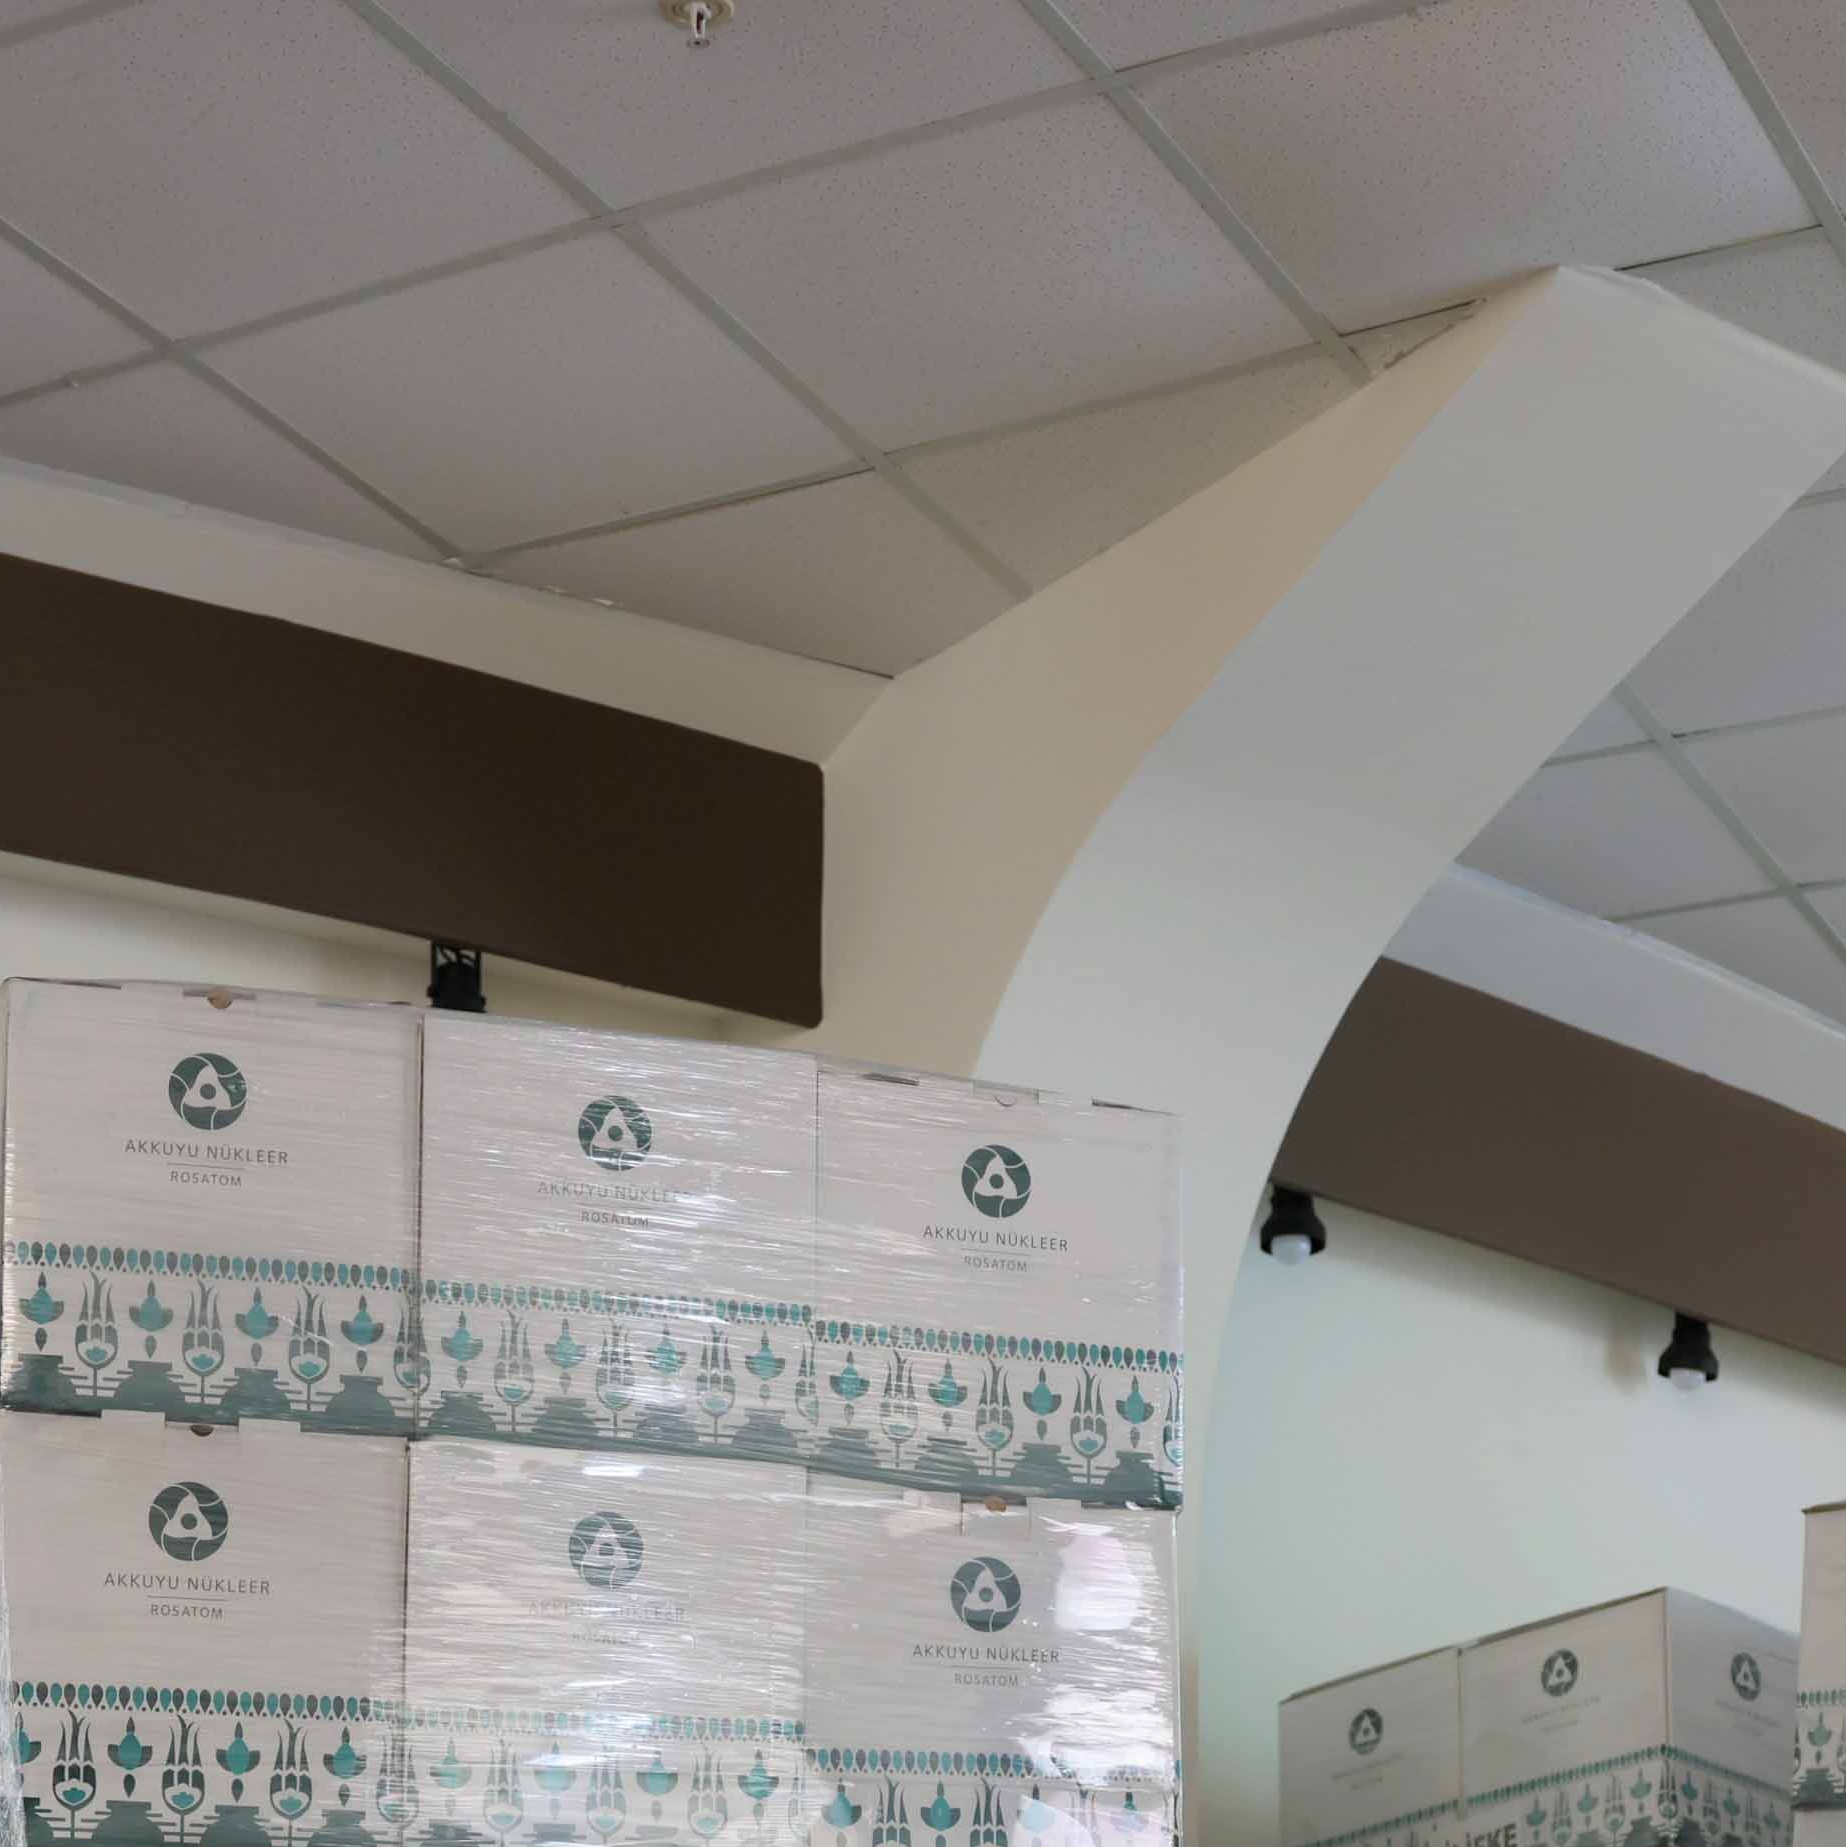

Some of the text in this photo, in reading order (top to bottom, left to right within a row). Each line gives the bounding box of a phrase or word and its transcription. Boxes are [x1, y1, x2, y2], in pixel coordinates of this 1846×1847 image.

[124, 1139, 289, 1165] AKKUYU NÜKLEER
[169, 1170, 242, 1187] ROSATOM
[923, 1225, 1068, 1252] AKKUYU NÜKLEER
[963, 1256, 1027, 1273] ROSATOM
[104, 1573, 271, 1595] AKKUYU NÜKLEER
[150, 1604, 224, 1619] ROSATOM
[912, 1643, 1060, 1664] AKKUYU NÜKLEER
[954, 1672, 1019, 1688] ROSATOM
